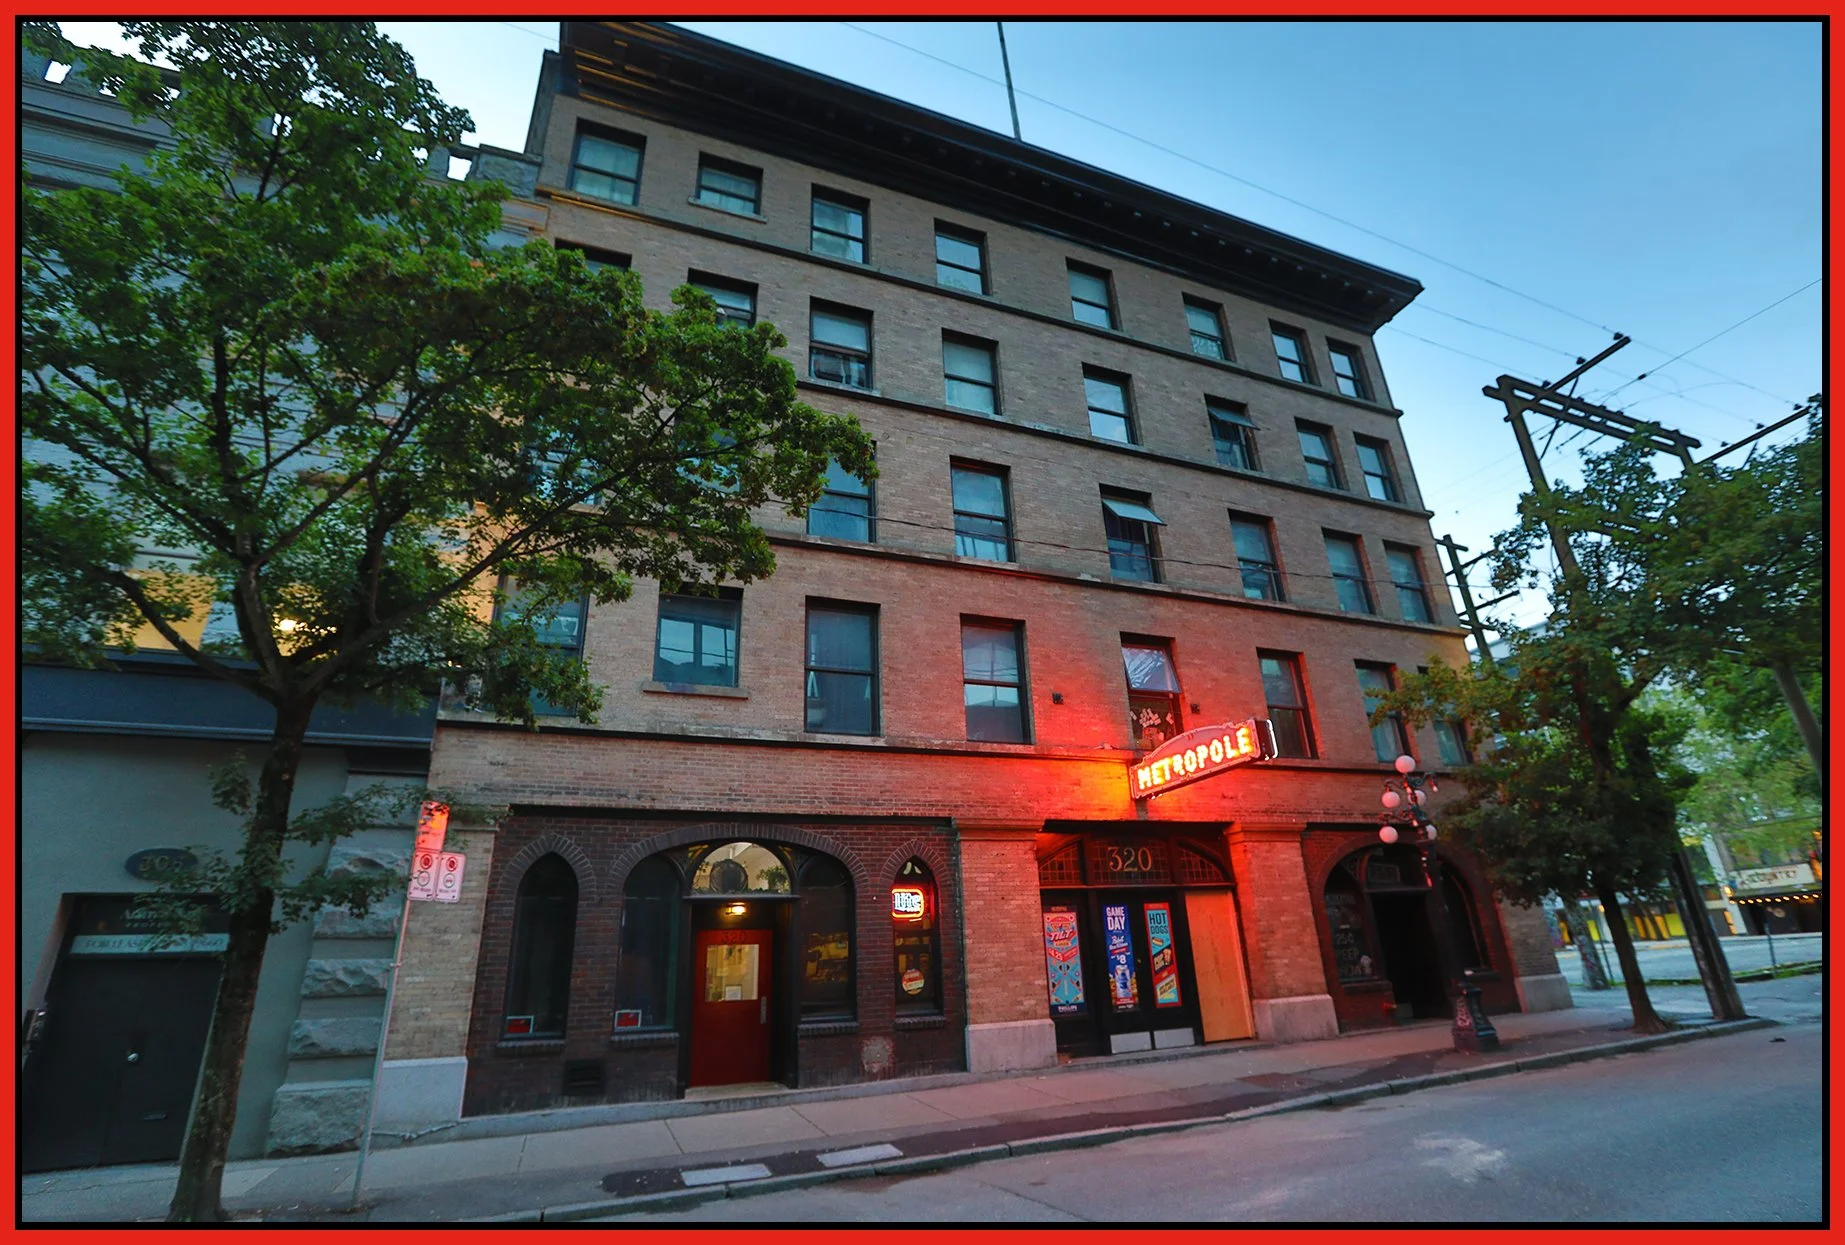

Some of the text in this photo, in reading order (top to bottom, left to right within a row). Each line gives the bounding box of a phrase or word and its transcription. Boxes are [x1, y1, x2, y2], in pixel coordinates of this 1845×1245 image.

[1137, 727, 1253, 790] METROPOLE
[1107, 846, 1152, 872] 320
[1106, 907, 1125, 917] GAME
[1107, 917, 1126, 931] DAY
[1149, 913, 1167, 925] HOT
[1150, 925, 1169, 935] DOGS
